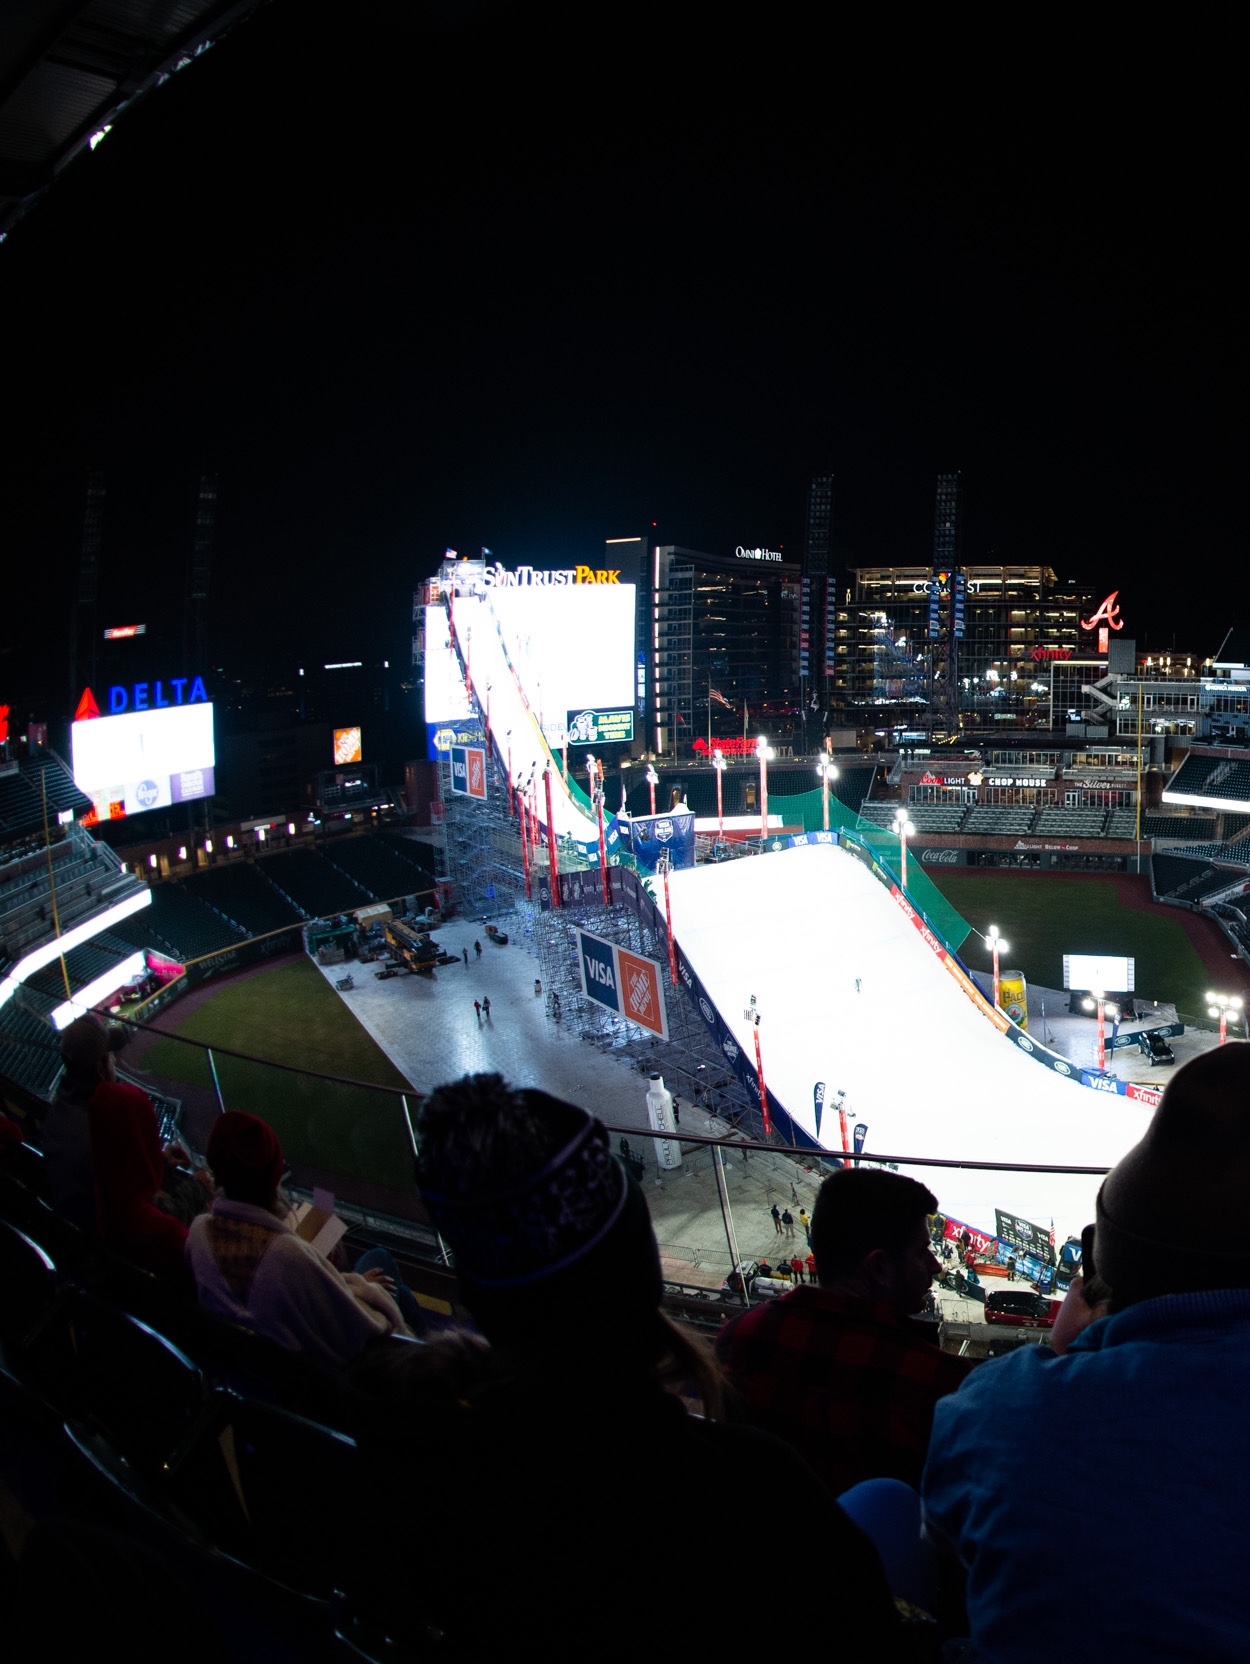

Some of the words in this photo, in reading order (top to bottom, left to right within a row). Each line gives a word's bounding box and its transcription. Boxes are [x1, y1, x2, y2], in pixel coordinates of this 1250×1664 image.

[761, 548, 783, 562] HOTEL
[575, 565, 621, 585] PARK
[1030, 647, 1073, 662] xfinity
[109, 675, 208, 714] DELTA
[453, 761, 467, 778] VISA
[920, 773, 944, 785] Coors
[989, 777, 1013, 786] CHOP
[1016, 778, 1047, 787] HOUSE
[1082, 779, 1111, 789] Silver
[793, 834, 809, 846] VISA
[816, 832, 832, 843] VISA
[895, 892, 916, 919] xfinity
[920, 925, 943, 954] xfinity
[584, 954, 616, 990] VISA
[678, 960, 693, 989] VISA
[1088, 1075, 1118, 1093] VISA
[816, 1083, 826, 1103] VISA
[1134, 1088, 1161, 1106] xfinit
[663, 1144, 673, 1166] PAUL
[1001, 1215, 1012, 1224] VISA
[1037, 1231, 1049, 1242] VISA
